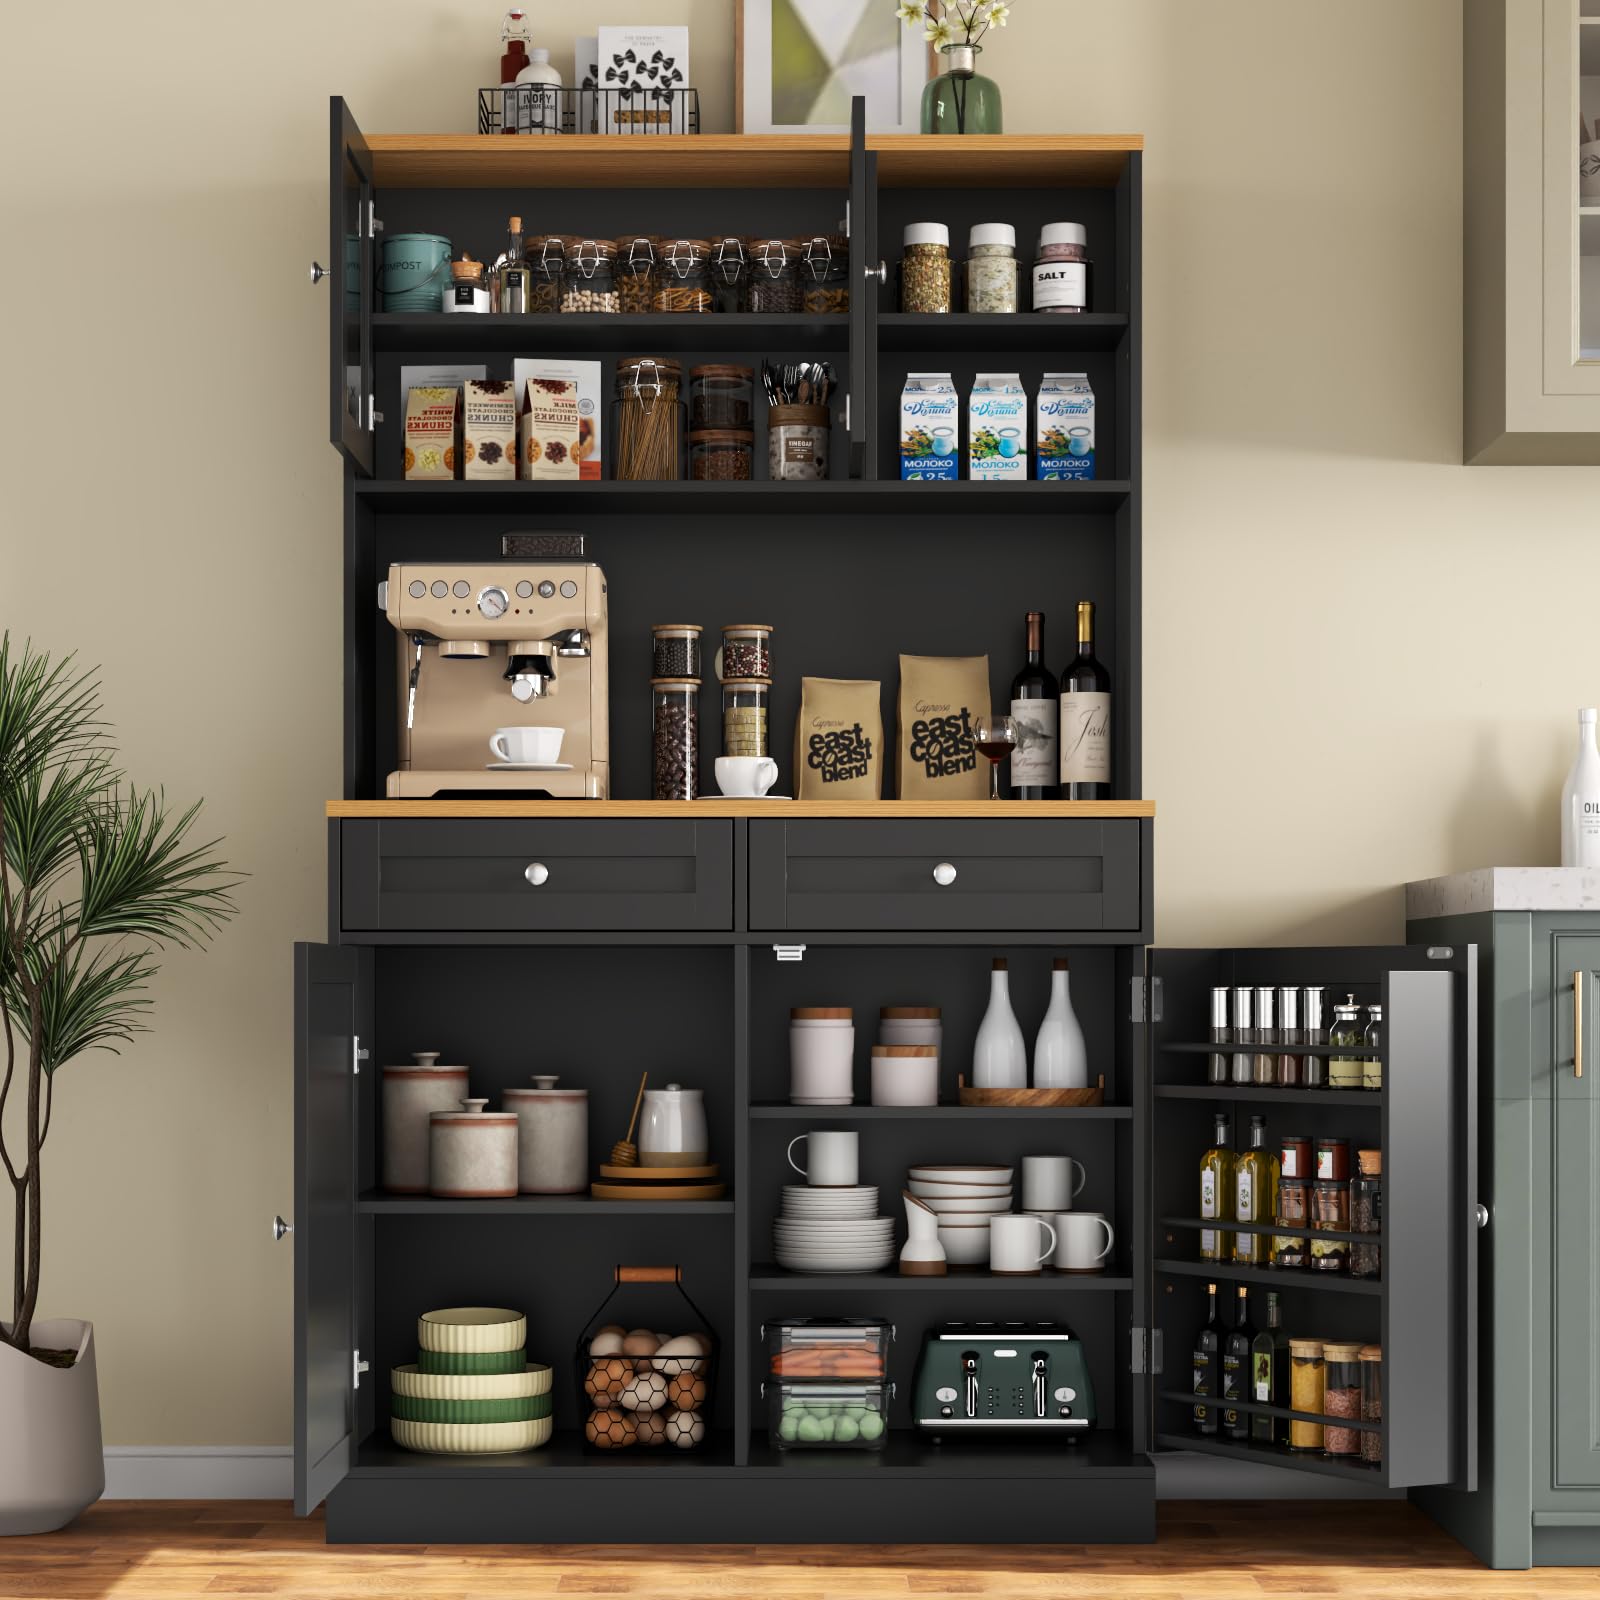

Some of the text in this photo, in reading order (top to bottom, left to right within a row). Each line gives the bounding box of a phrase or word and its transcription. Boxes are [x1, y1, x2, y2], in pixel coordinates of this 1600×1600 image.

[523, 93, 552, 105] IVORY
[384, 261, 422, 271] OMPOST
[1038, 271, 1067, 281] SALT
[904, 460, 954, 468] МОЛОКО
[971, 461, 1020, 469] МОЛОКО
[1041, 460, 1090, 468] МОЛОКО
[912, 706, 972, 741] east
[809, 723, 863, 752] east
[808, 737, 872, 769] coast
[910, 733, 975, 762] coas
[925, 748, 976, 778] blend
[822, 758, 868, 783] blend
[1584, 802, 1600, 813] OIL
